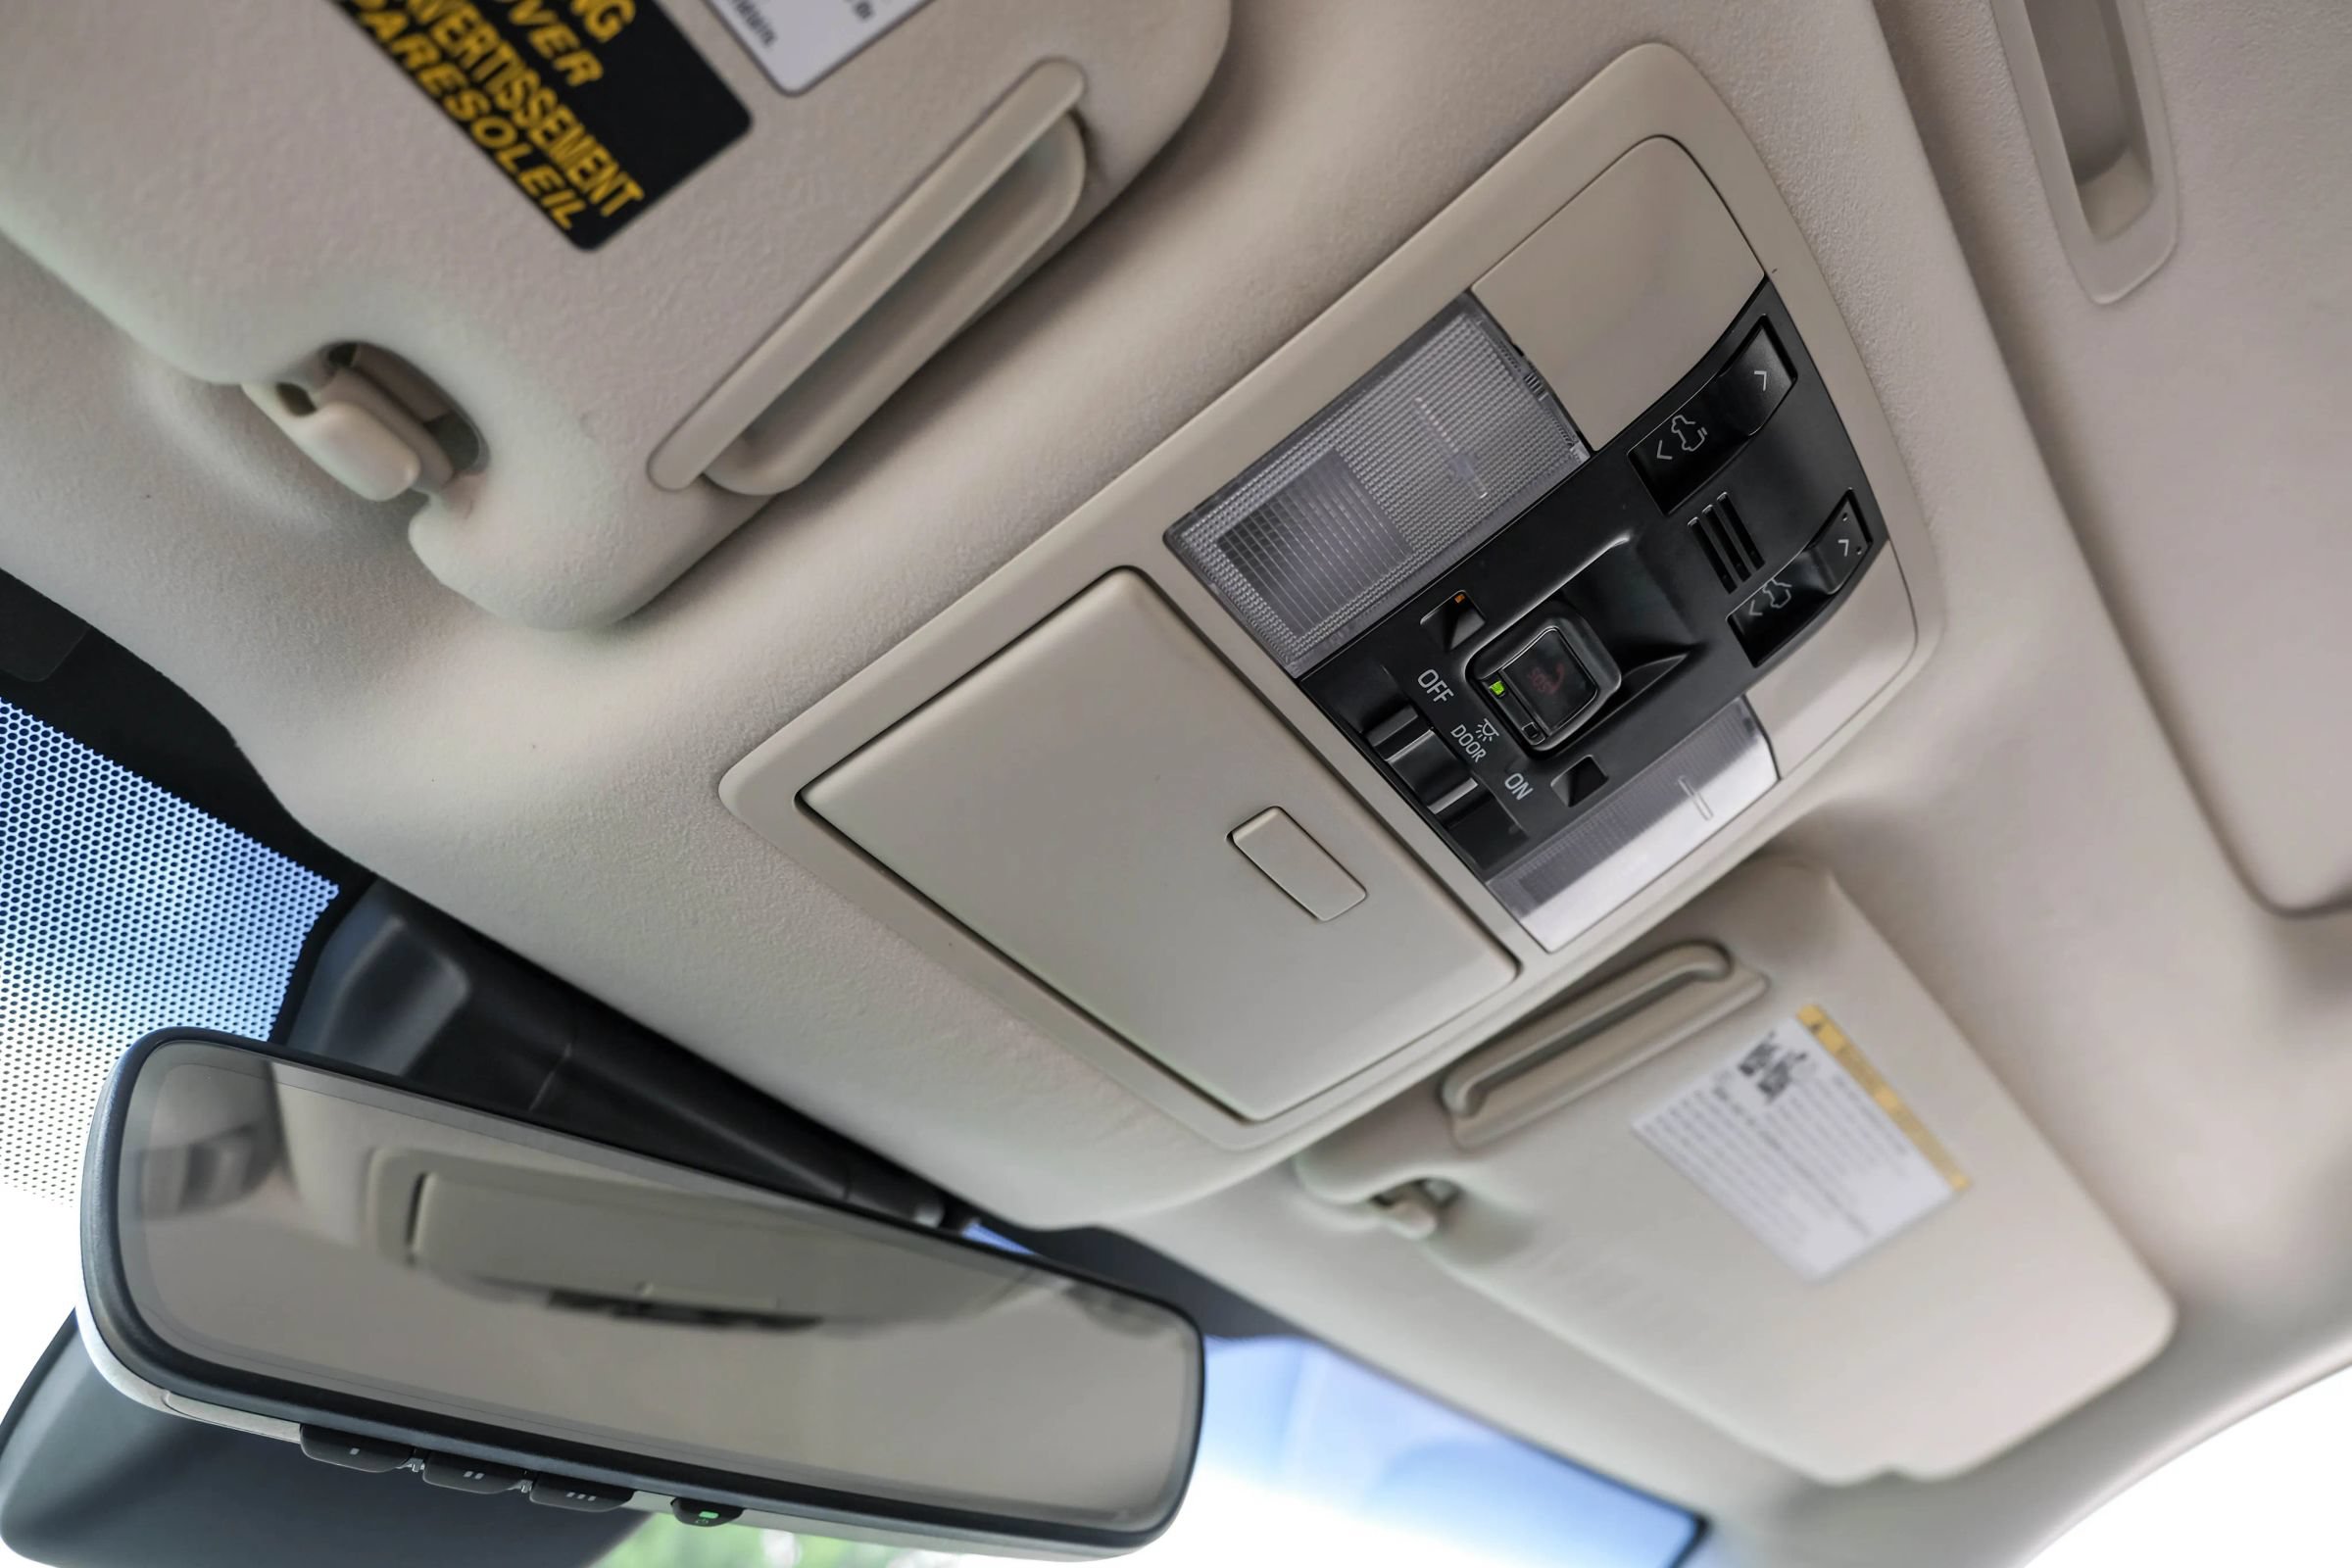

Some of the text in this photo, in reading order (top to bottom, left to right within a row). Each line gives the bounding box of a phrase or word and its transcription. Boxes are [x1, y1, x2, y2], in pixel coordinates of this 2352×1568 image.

[493, 0, 604, 86] VER
[1417, 668, 1454, 703] OFF
[1450, 724, 1487, 762] DOOR
[1504, 772, 1534, 800] ON
